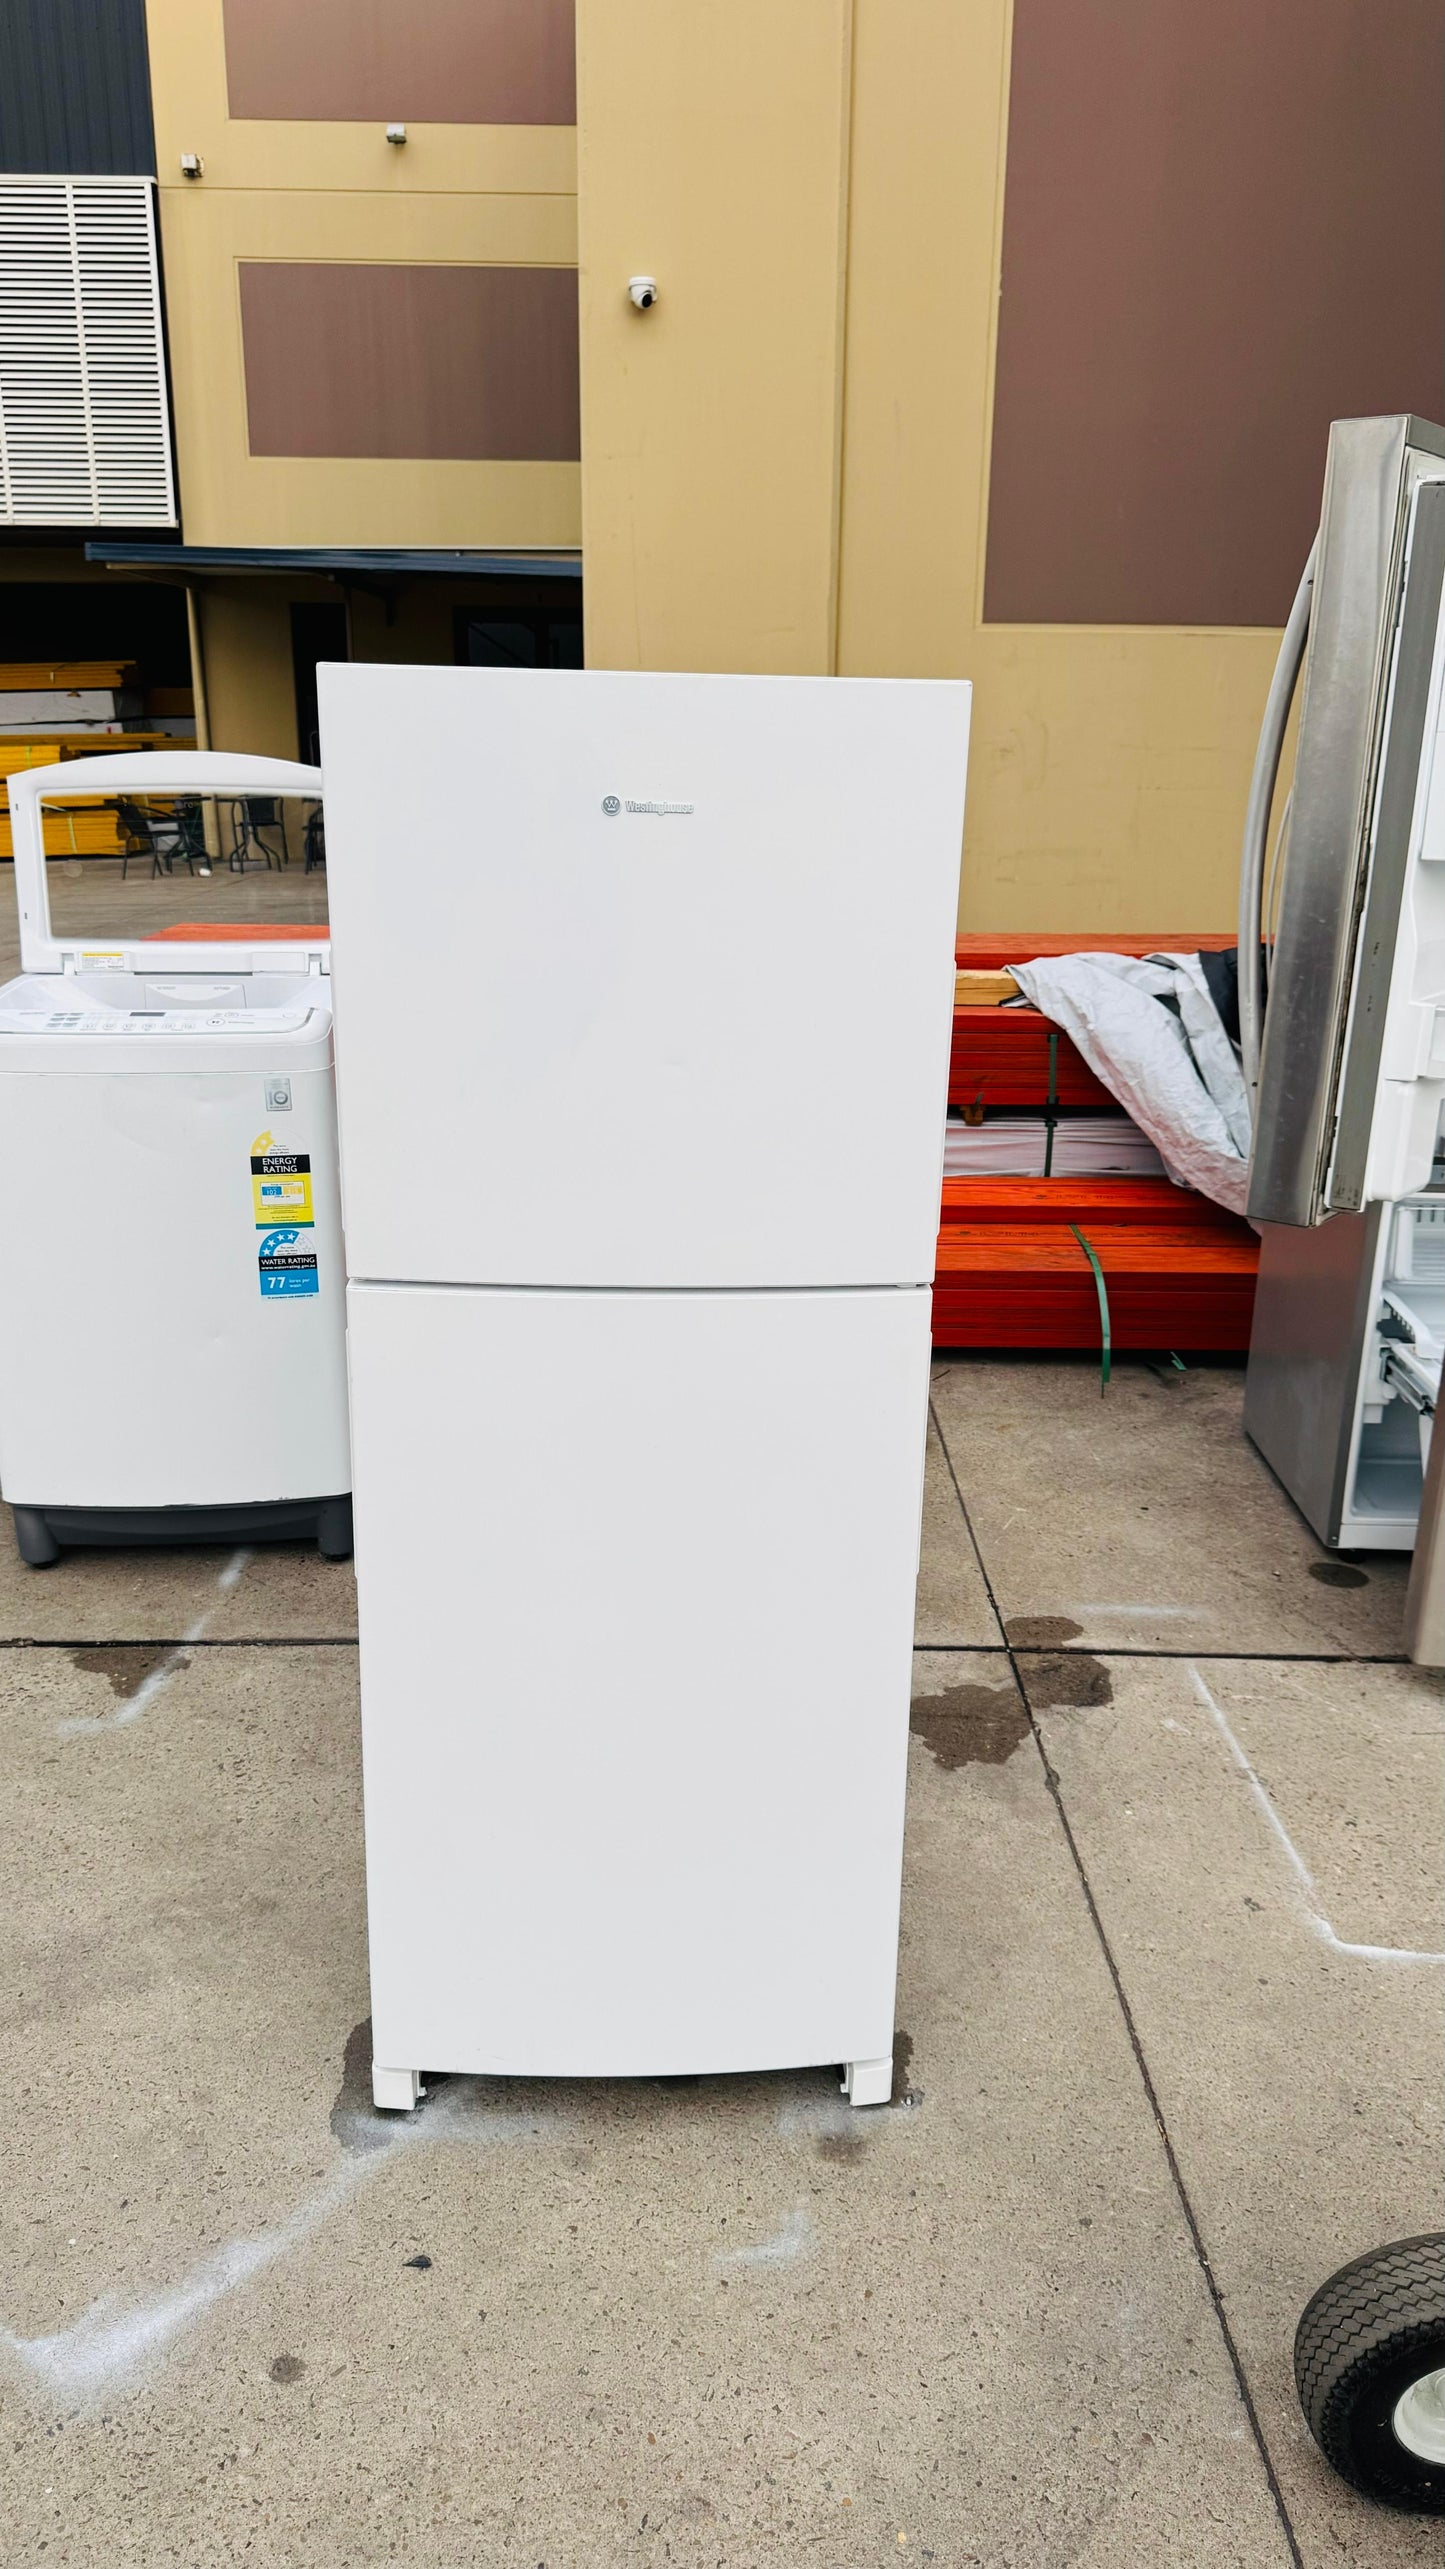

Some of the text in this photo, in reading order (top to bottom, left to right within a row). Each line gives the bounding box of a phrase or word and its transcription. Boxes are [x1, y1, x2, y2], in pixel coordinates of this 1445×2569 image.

[625, 800, 694, 816] Westinghouse
[262, 1157, 298, 1165] ENERGY
[263, 1165, 298, 1173] RATING
[267, 1276, 286, 1289] 77
